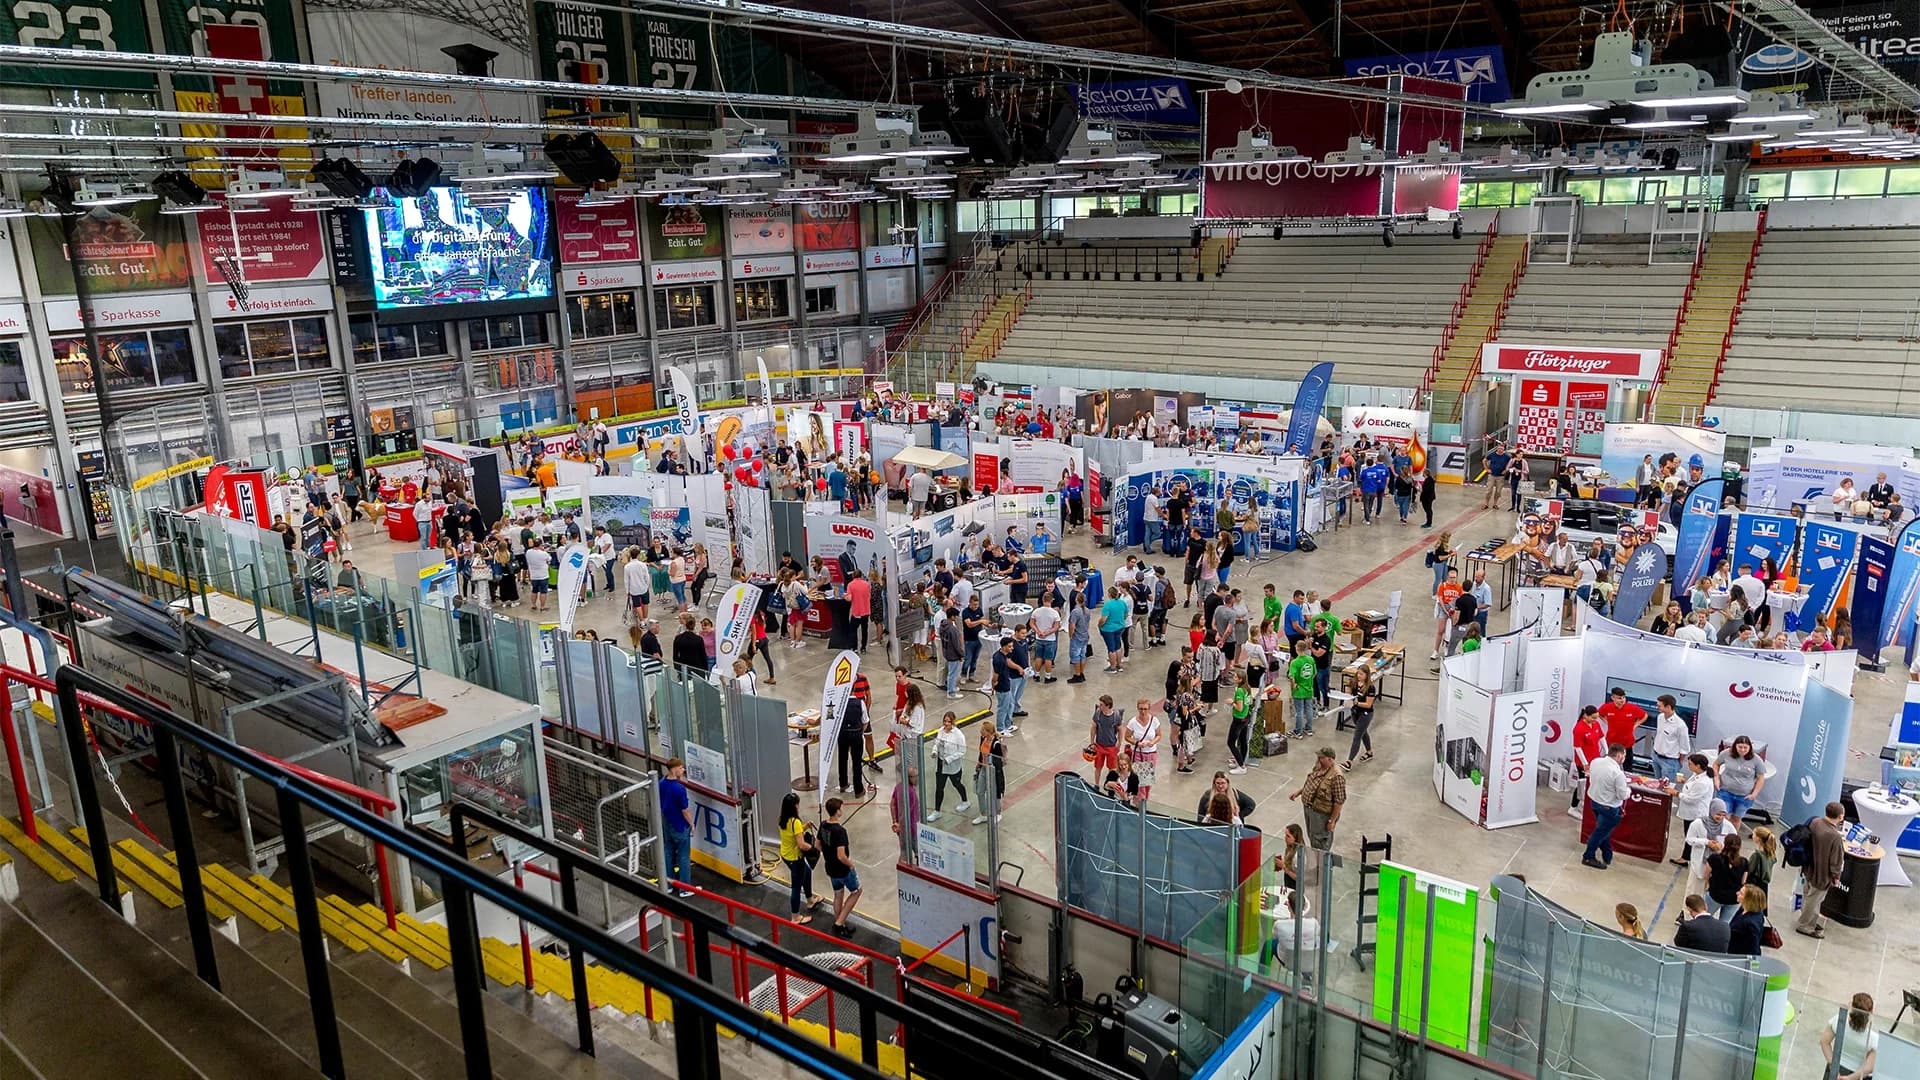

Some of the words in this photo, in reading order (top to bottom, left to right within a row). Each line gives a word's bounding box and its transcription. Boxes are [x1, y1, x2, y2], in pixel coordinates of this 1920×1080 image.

[1843, 14, 1875, 24] Feiern
[1878, 12, 1892, 20] so
[12, 0, 117, 51] 23
[556, 12, 604, 39] HILGER
[648, 21, 670, 35] KARL
[1848, 23, 1870, 32] sein
[1872, 19, 1902, 29] kann.
[649, 35, 697, 61] FRIESEN
[1357, 60, 1453, 76] SCHOLZ
[651, 62, 698, 90] 27
[352, 85, 400, 103] Treffer
[403, 88, 456, 105] landen.
[1079, 87, 1153, 104] SCHOLZ
[337, 107, 382, 120] Nimm
[385, 109, 411, 122] das
[415, 111, 453, 123] Spiel
[455, 115, 463, 123] in
[466, 113, 486, 124] die
[808, 203, 850, 219] echo
[283, 221, 303, 229] 1928!
[256, 233, 268, 241] seit
[270, 232, 290, 240] 1984!
[668, 238, 686, 247] Echt.
[688, 238, 703, 247] Gut.
[252, 244, 272, 252] Team
[274, 243, 283, 251] ab
[284, 243, 309, 252] sofort?
[444, 249, 481, 261] ganzen
[482, 246, 520, 258] Branche
[79, 263, 115, 277] Echt.
[120, 262, 150, 275] Gut.
[666, 272, 690, 280] Gewinnen
[698, 270, 717, 278] einfach.
[754, 265, 780, 275] Sparkasse
[591, 276, 624, 287] Sparkasse
[246, 300, 269, 311] rfolg
[271, 298, 281, 308] ist
[283, 297, 315, 307] einfach.
[101, 308, 161, 322] Sparkasse
[1524, 350, 1611, 372] Flötzinger
[1115, 392, 1132, 401] Gabor
[167, 440, 189, 448] COFFEE
[1782, 471, 1824, 480] GASTRONOMIE
[1803, 468, 1838, 476] HOTELLERIE
[1631, 578, 1655, 588] POLIZEI
[731, 622, 742, 640] SHK
[1550, 667, 1561, 711] SWRO.de
[1757, 685, 1802, 698] stadtwerke
[1756, 692, 1801, 705] rosenheim
[1508, 700, 1534, 783] komro
[1809, 719, 1828, 767] SWRO.de
